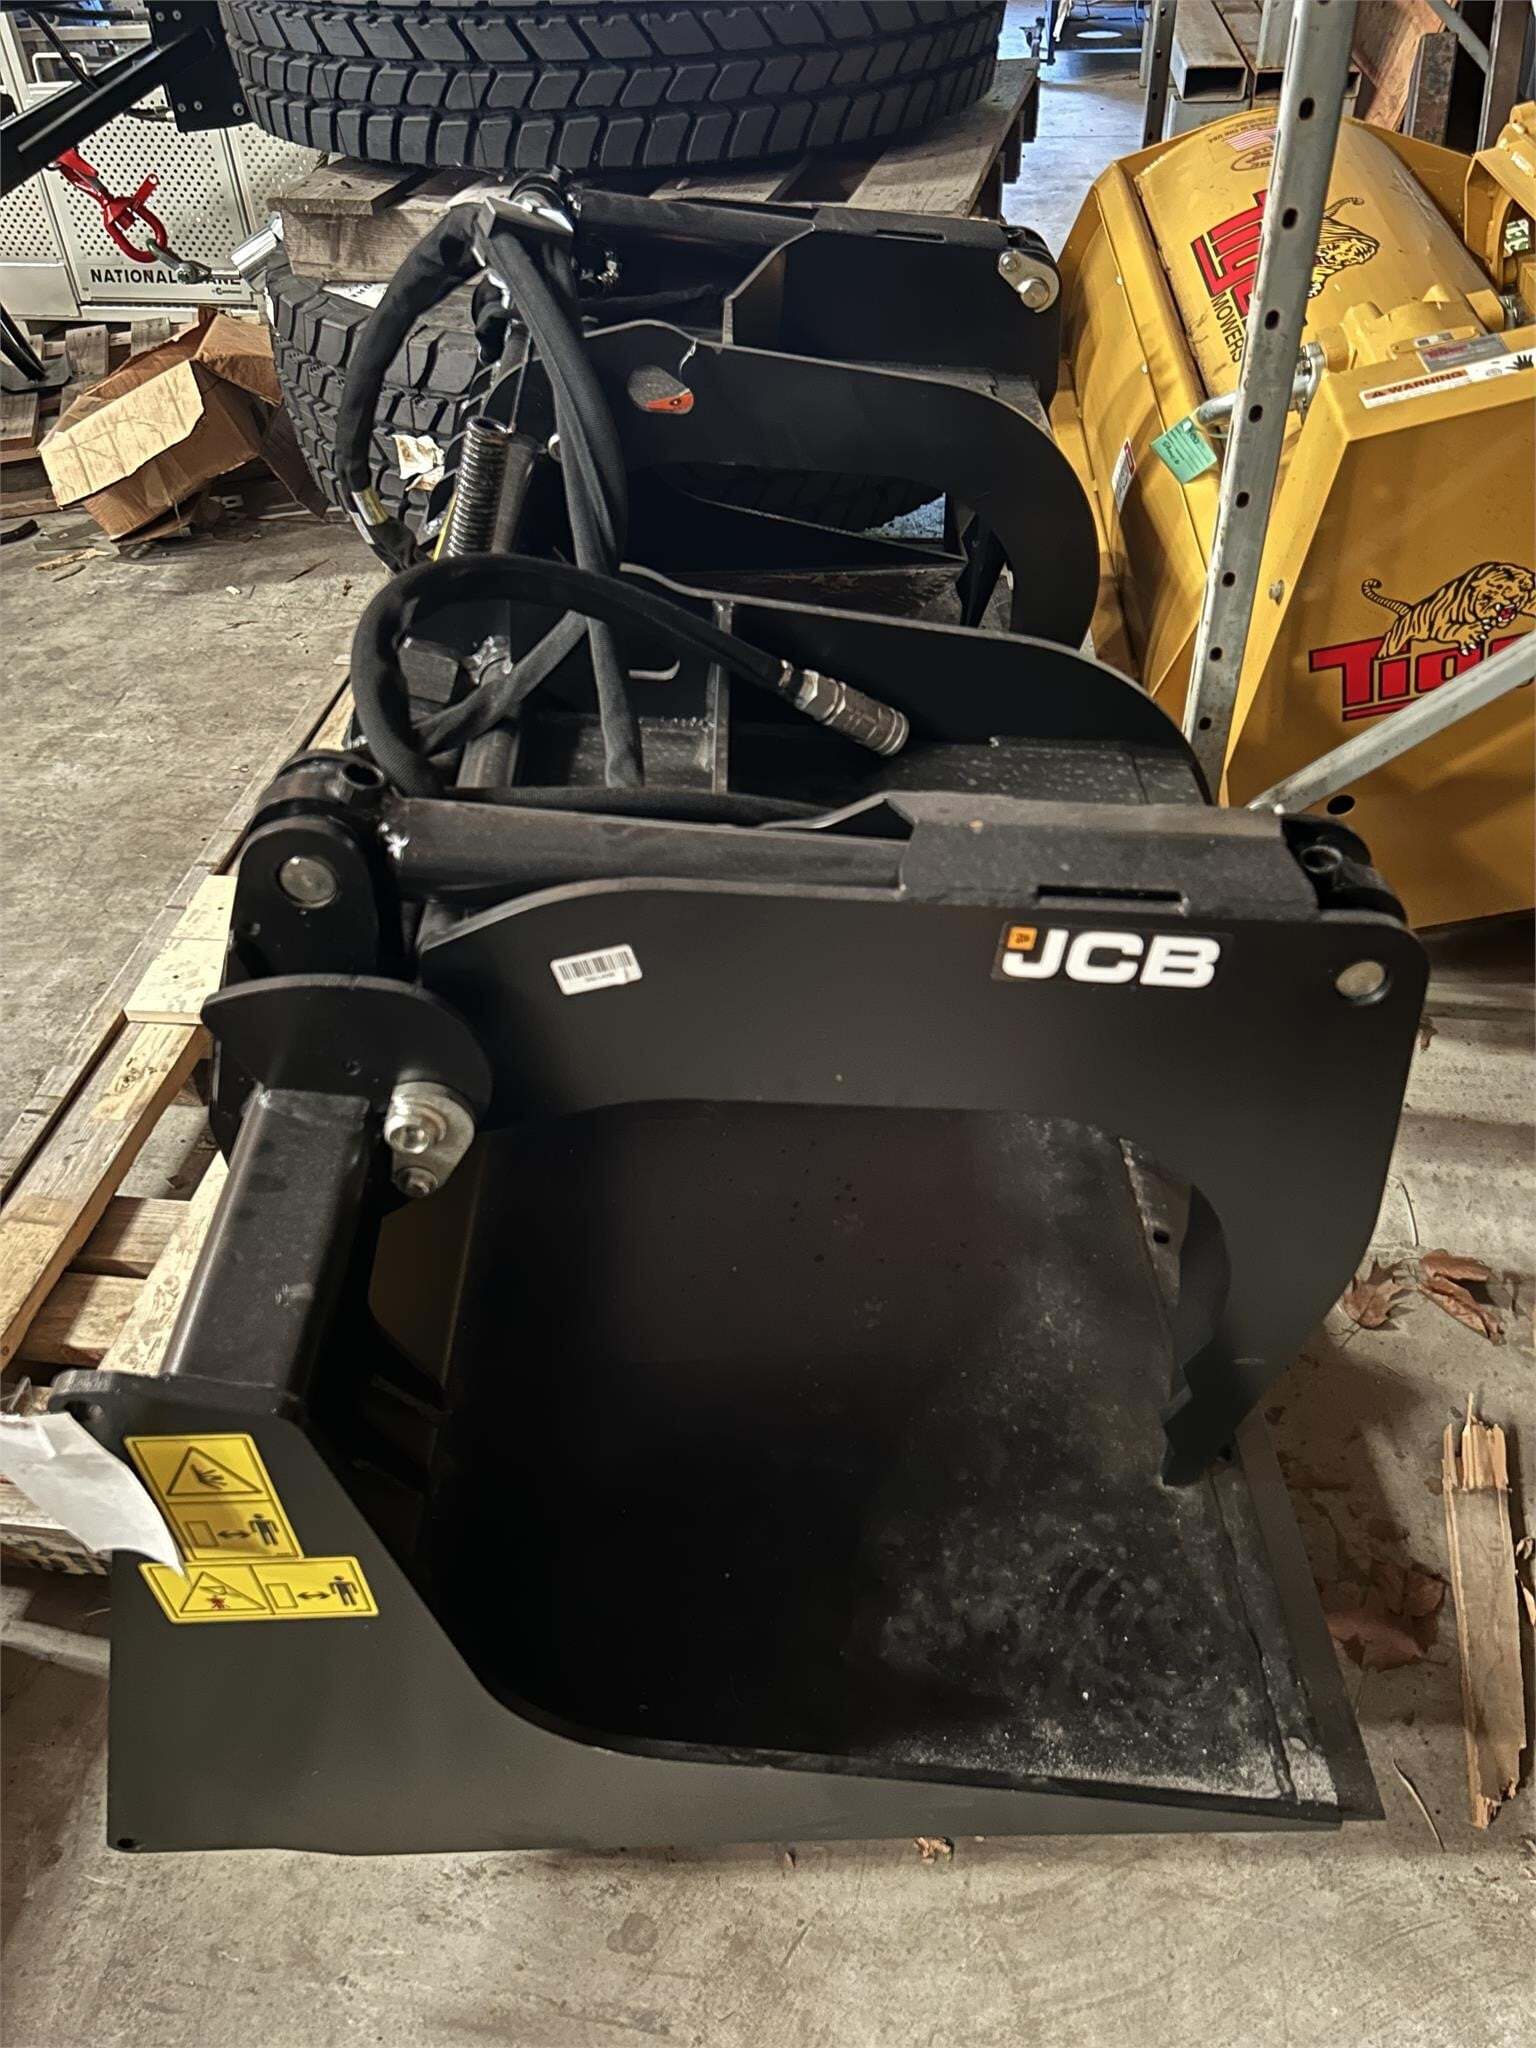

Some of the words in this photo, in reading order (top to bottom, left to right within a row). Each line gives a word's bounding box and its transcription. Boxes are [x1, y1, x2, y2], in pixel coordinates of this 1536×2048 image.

[90, 268, 178, 284] NATIONAL
[1211, 292, 1245, 364] MOWERS
[1387, 369, 1464, 394] WARNING
[1002, 928, 1221, 989] JCB
